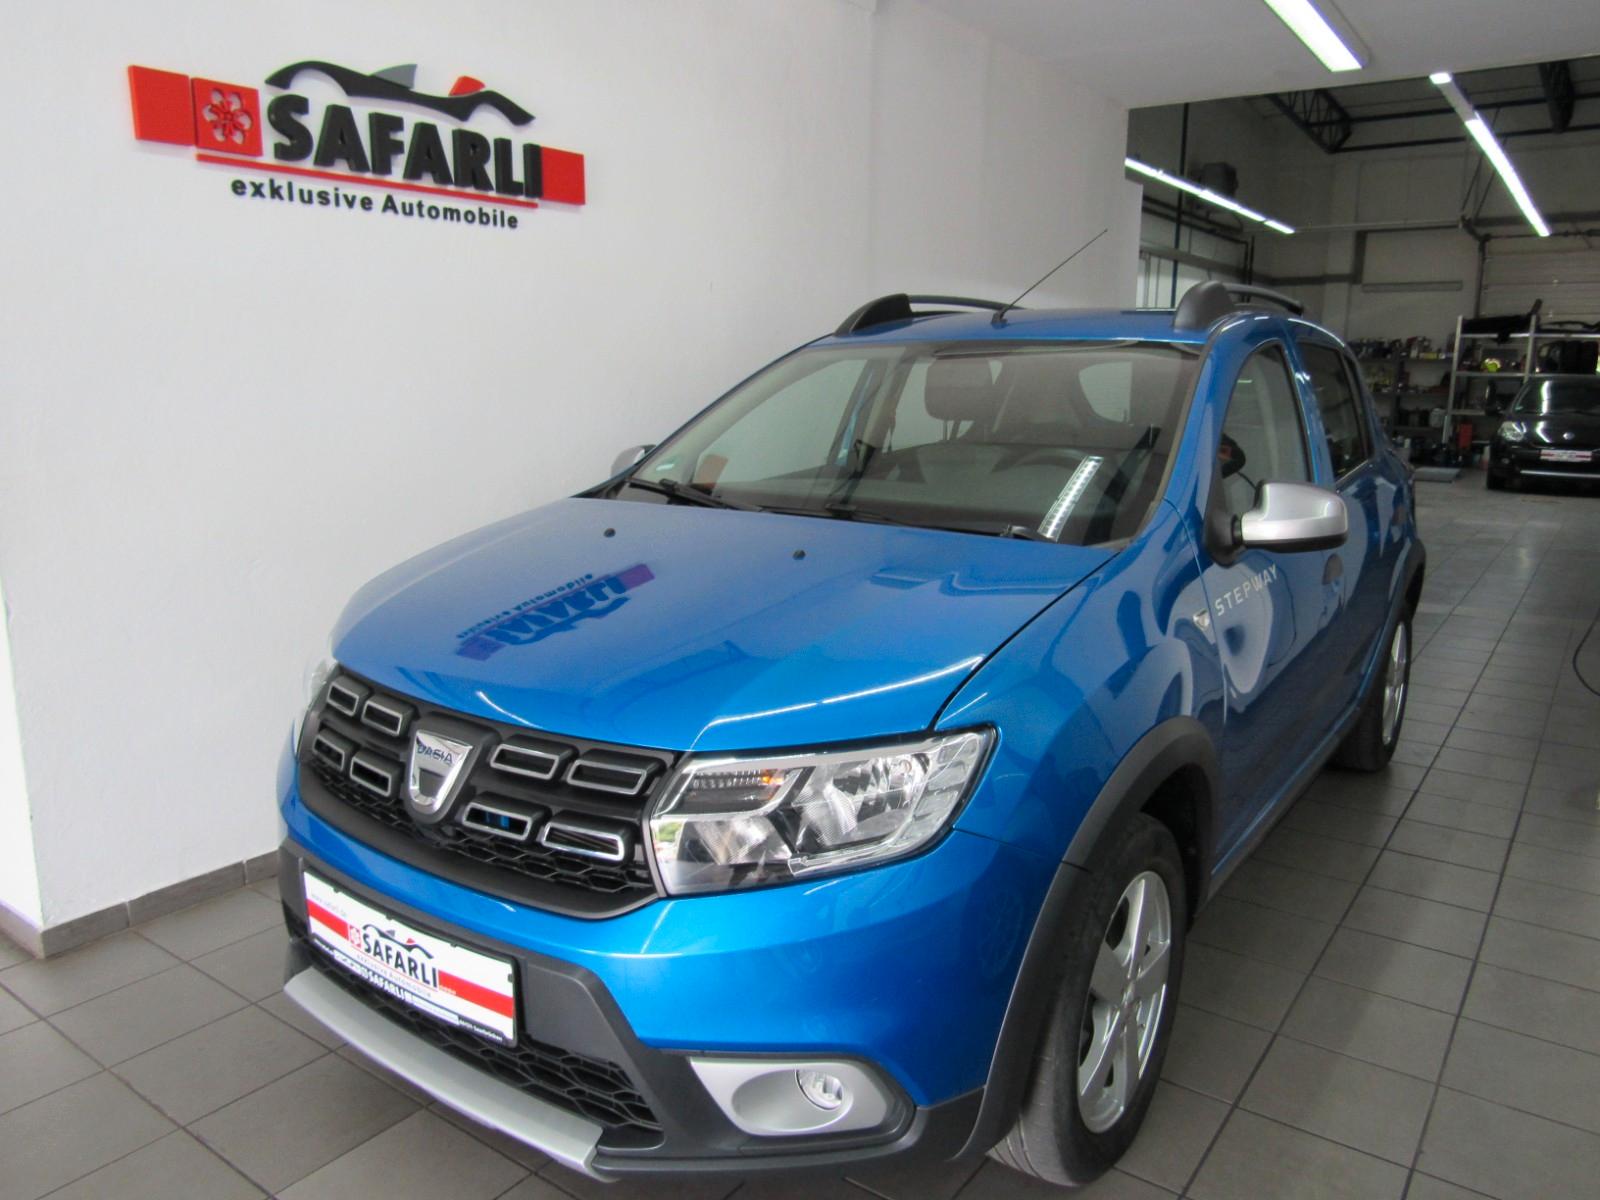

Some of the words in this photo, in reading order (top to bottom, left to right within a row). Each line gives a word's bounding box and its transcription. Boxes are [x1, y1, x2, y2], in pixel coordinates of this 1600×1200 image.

[267, 94, 542, 198] SAFARLI
[231, 175, 373, 212] exklusive
[381, 194, 519, 230] Automobile
[1214, 563, 1278, 617] STEPWAY
[362, 933, 438, 988] SAFARLI
